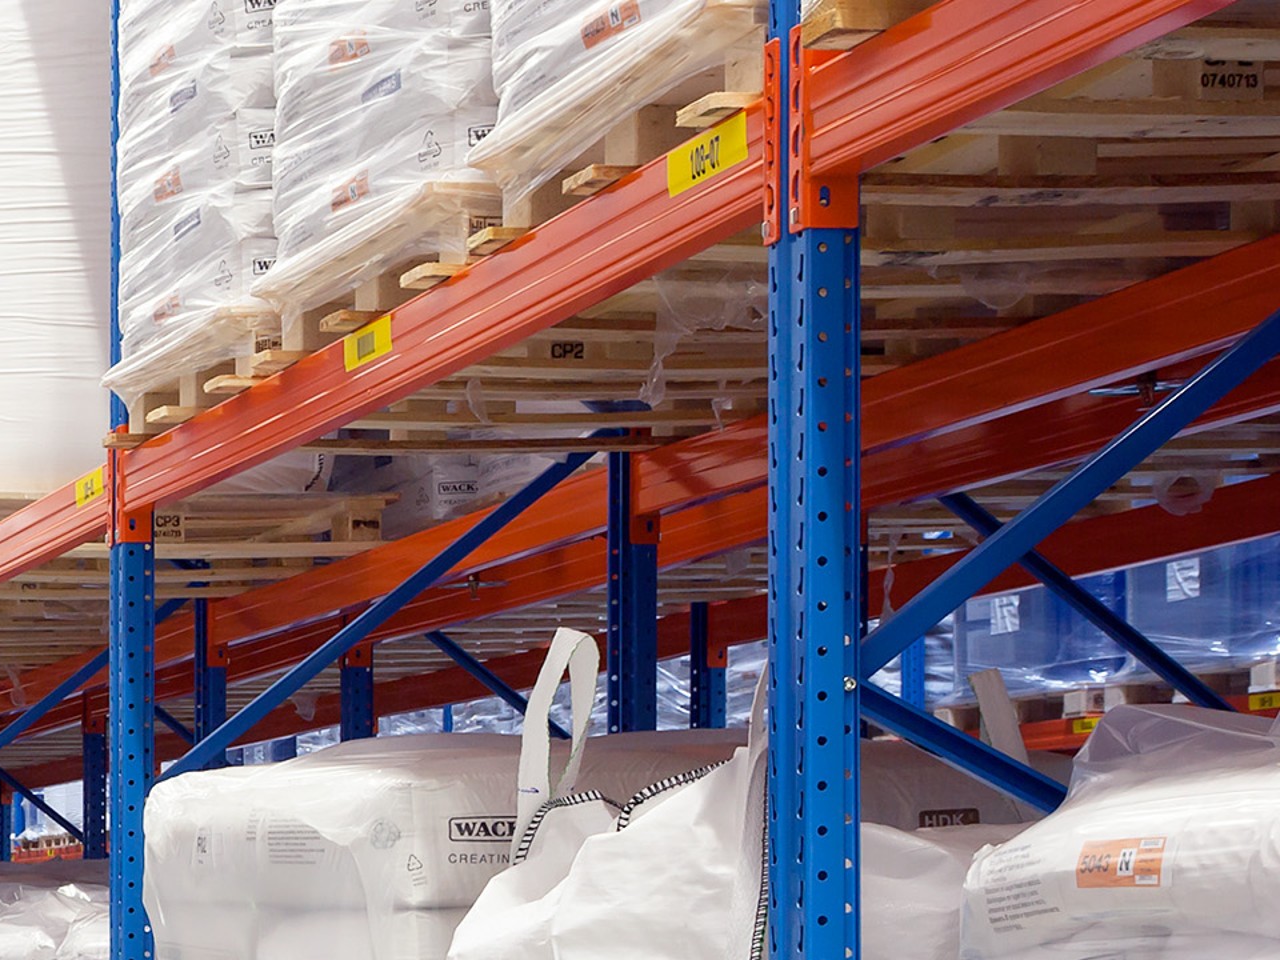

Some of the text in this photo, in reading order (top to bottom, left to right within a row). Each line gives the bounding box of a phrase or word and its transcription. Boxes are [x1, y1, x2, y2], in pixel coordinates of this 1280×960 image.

[1201, 73, 1259, 88] 0740713
[551, 343, 584, 359] CP2
[155, 514, 181, 527] CP3
[1080, 854, 1112, 875] 5043
